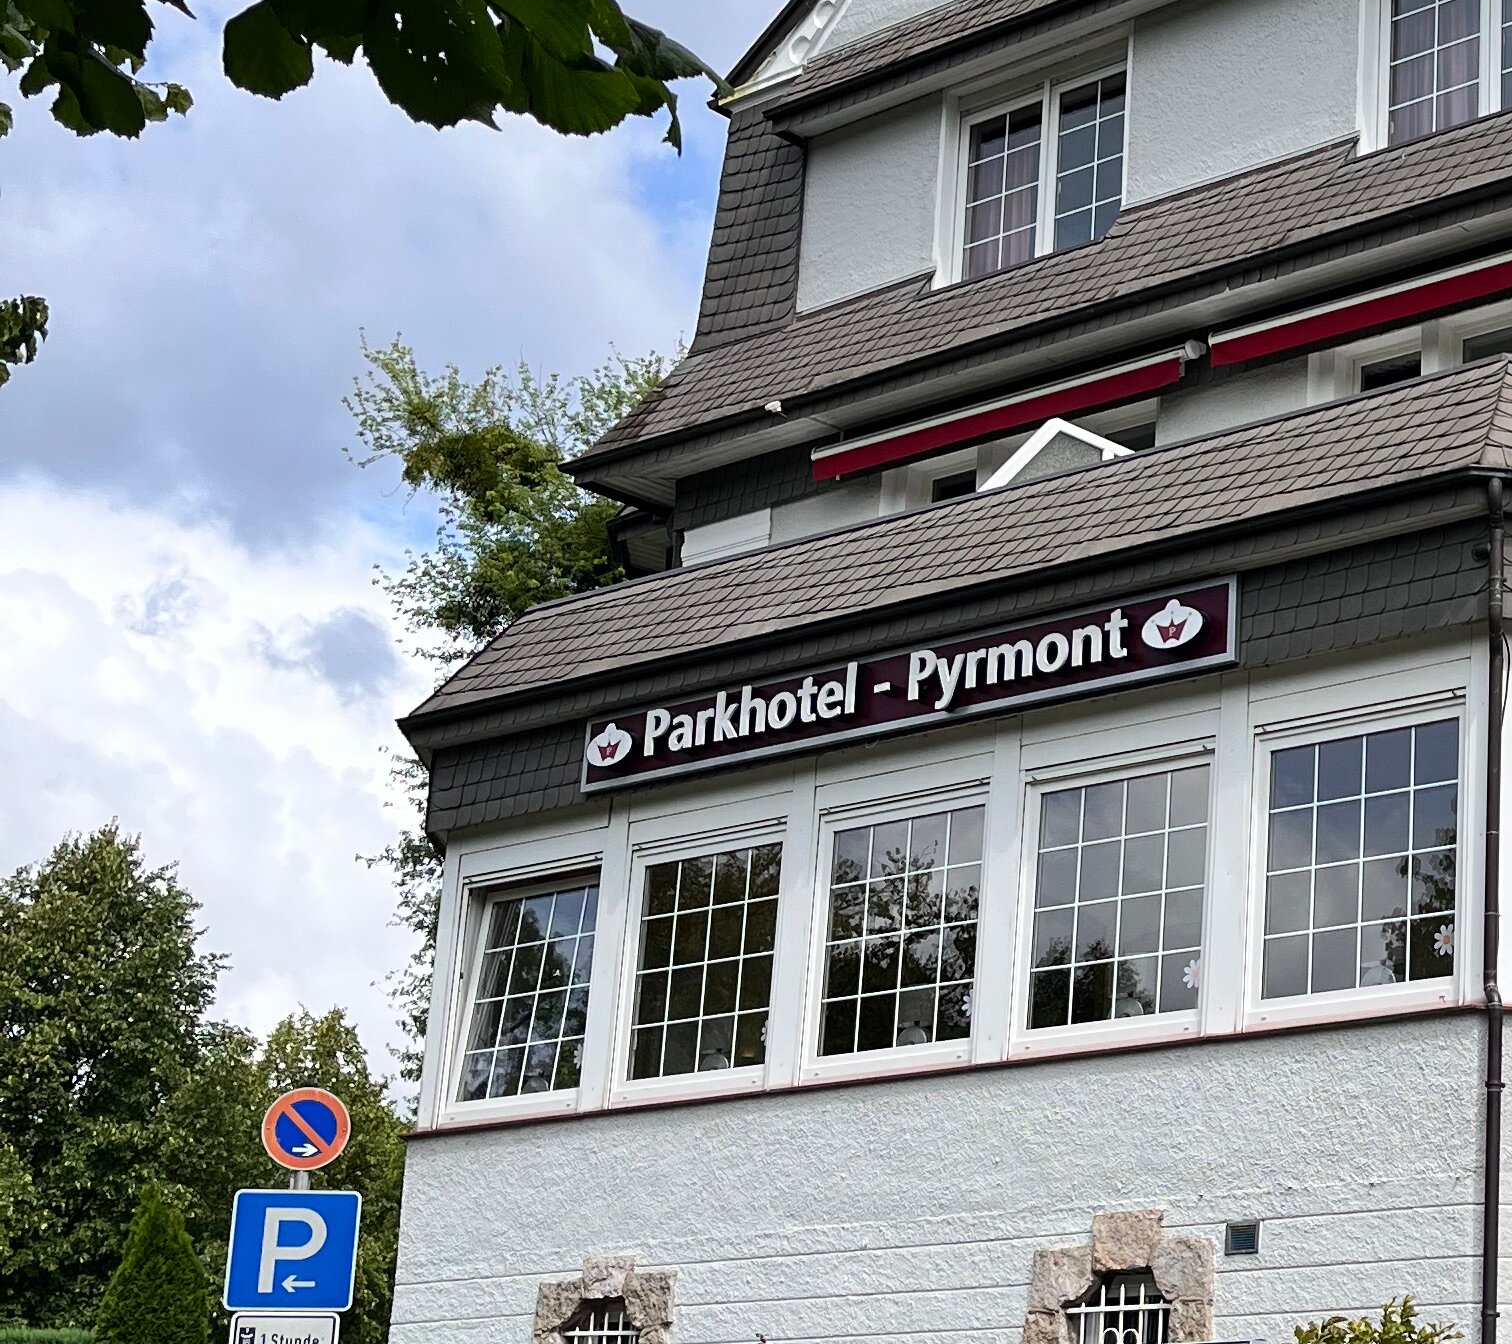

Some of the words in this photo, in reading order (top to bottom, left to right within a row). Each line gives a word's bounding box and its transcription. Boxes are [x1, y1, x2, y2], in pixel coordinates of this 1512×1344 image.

[643, 661, 859, 757] Parkhotel
[873, 682, 891, 694] -
[907, 608, 1129, 710] Pyrmont
[257, 1207, 328, 1294] P
